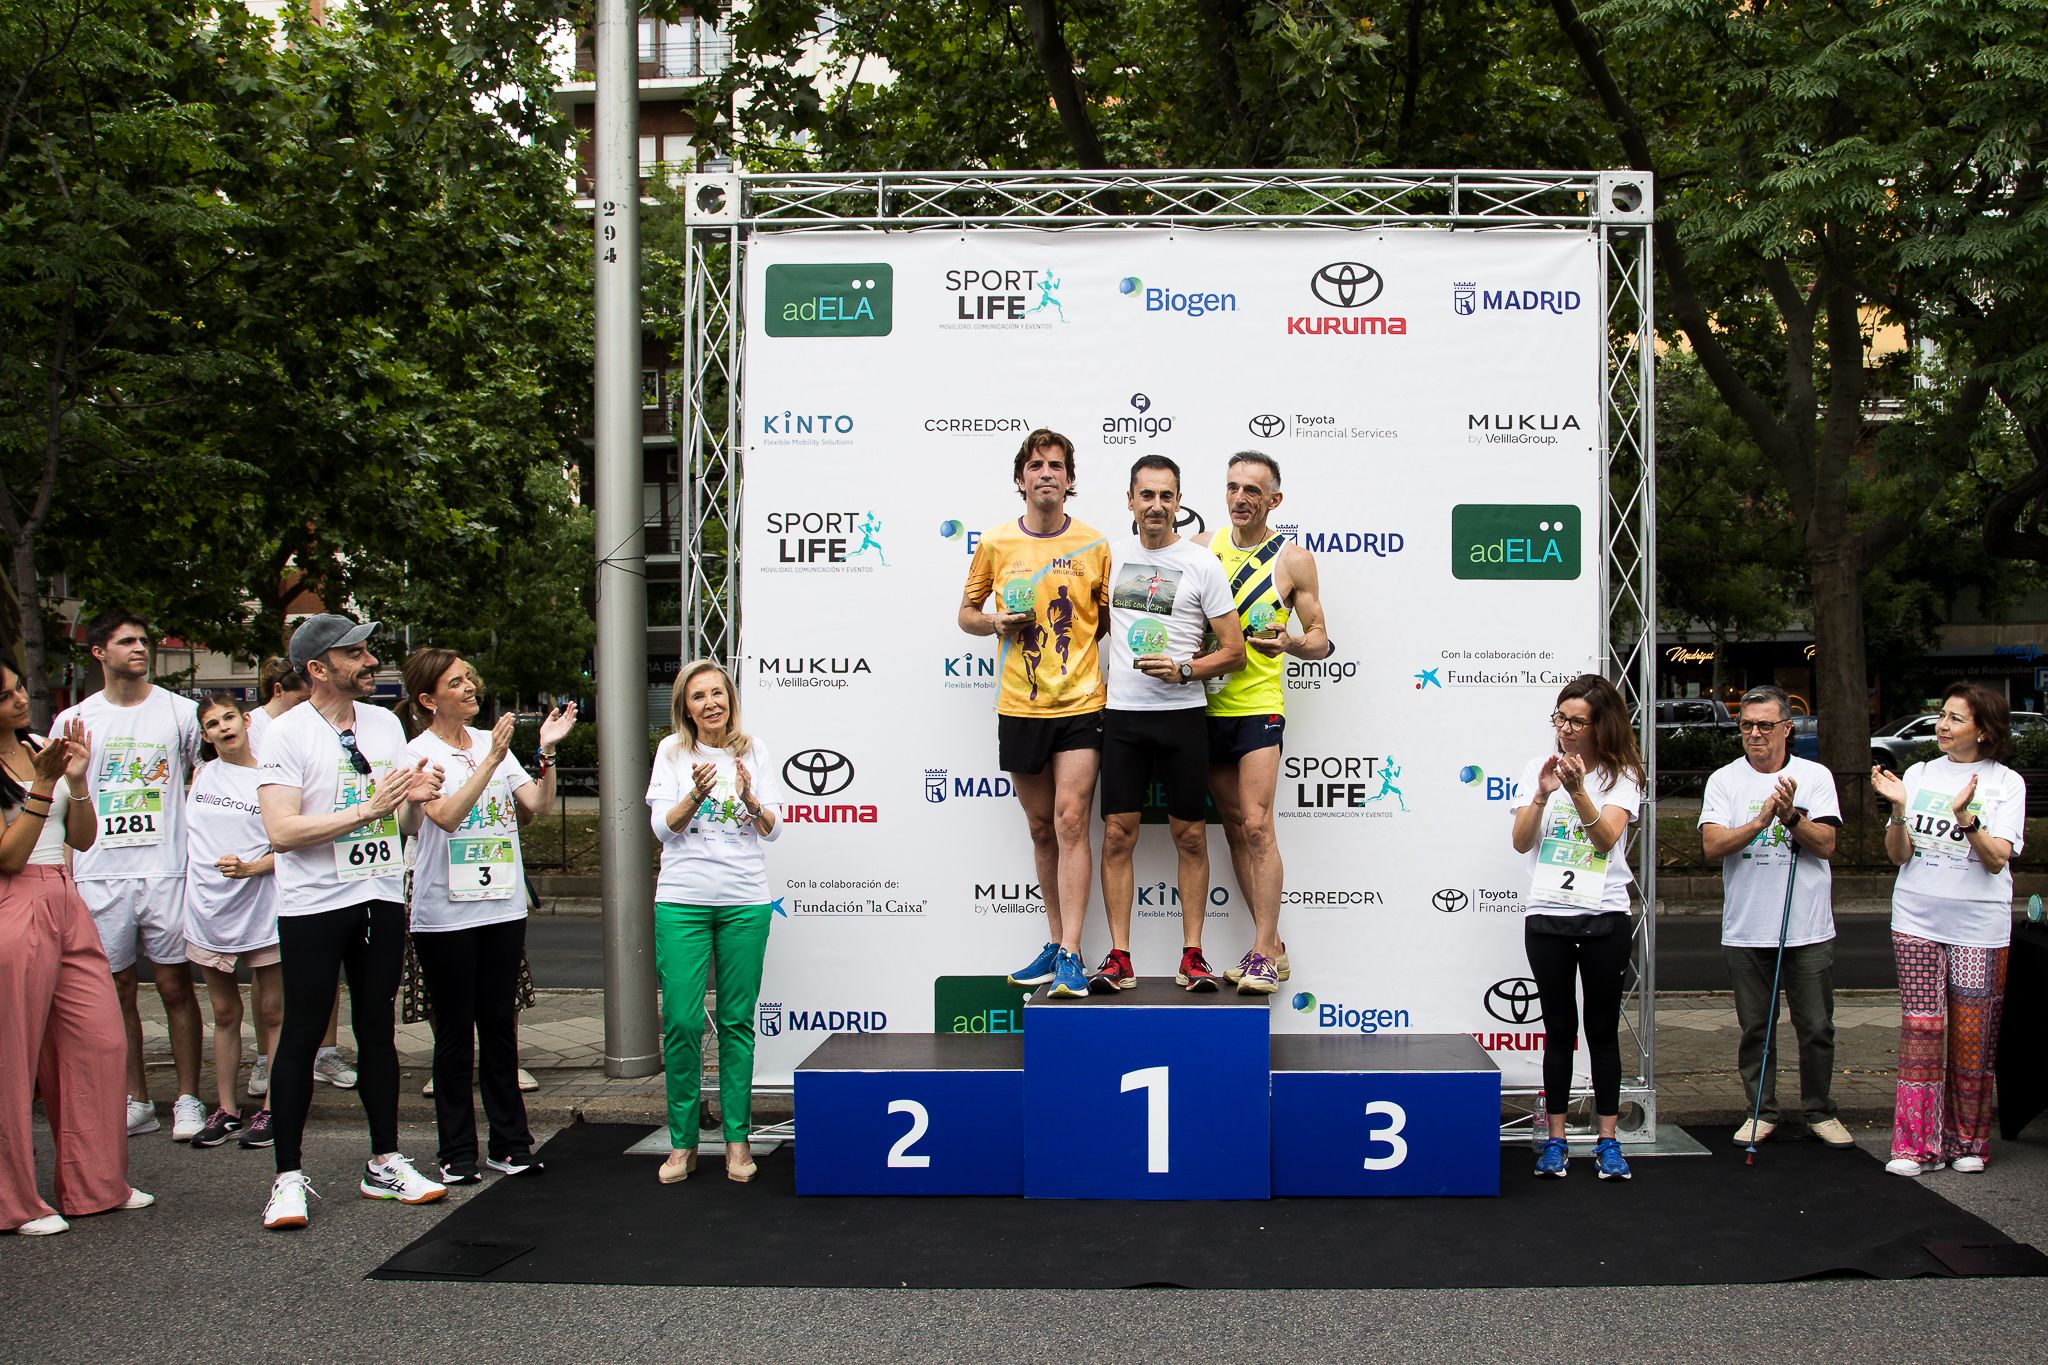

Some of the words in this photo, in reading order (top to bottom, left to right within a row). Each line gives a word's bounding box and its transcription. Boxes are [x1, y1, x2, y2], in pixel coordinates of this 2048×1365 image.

[602, 200, 617, 264] 294
[946, 270, 1038, 291] SPORT
[782, 296, 874, 321] adELA
[959, 296, 1025, 319] LIFE
[1147, 288, 1236, 316] Biogen
[1483, 290, 1580, 314] MADRID
[1103, 416, 1171, 437] amigo
[1296, 415, 1334, 426] Toyota
[1469, 415, 1580, 430] MUKUA
[1103, 435, 1136, 444] tours
[1296, 428, 1347, 438] Financial
[1351, 428, 1397, 438] Services
[1468, 434, 1483, 446] by
[1486, 434, 1557, 445] VelillaGroup.
[767, 513, 859, 533] SPORT
[780, 539, 846, 562] LIFE
[1305, 533, 1404, 557] MADRID
[1470, 538, 1562, 563] adELA
[945, 652, 994, 676] KIN
[1442, 650, 1460, 658] Con
[1475, 650, 1536, 659] colaboración
[1538, 650, 1554, 659] de:
[760, 658, 871, 673] MUKUA
[1287, 662, 1356, 683] amigo
[759, 677, 773, 690] by
[777, 678, 848, 689] VelillaGroup.
[1287, 679, 1320, 689] tours
[1449, 671, 1517, 683] Fundación
[1285, 757, 1378, 778] SPORT
[955, 778, 1017, 797] MAD
[1298, 784, 1366, 807] LIFE
[195, 791, 262, 816] elillaGroup
[105, 814, 156, 836] 1281
[348, 840, 391, 866] 698
[478, 866, 492, 886] 3
[787, 880, 805, 888] Con
[809, 880, 817, 888] la
[820, 880, 881, 888] colaboración
[885, 880, 899, 888] de:
[1560, 870, 1575, 891] 2
[975, 884, 1043, 899] MUK
[1479, 889, 1517, 901] Toyota
[794, 900, 863, 912] Fundación
[975, 904, 988, 915] by
[992, 902, 1046, 913] VelillaGro
[1480, 903, 1526, 912] Financia
[789, 1011, 887, 1033] MADRID
[953, 1010, 1024, 1033] adEL
[1320, 1004, 1409, 1032] Biogen
[1120, 1066, 1169, 1173] 1
[887, 1099, 930, 1168] 2
[1363, 1101, 1408, 1171] 3
